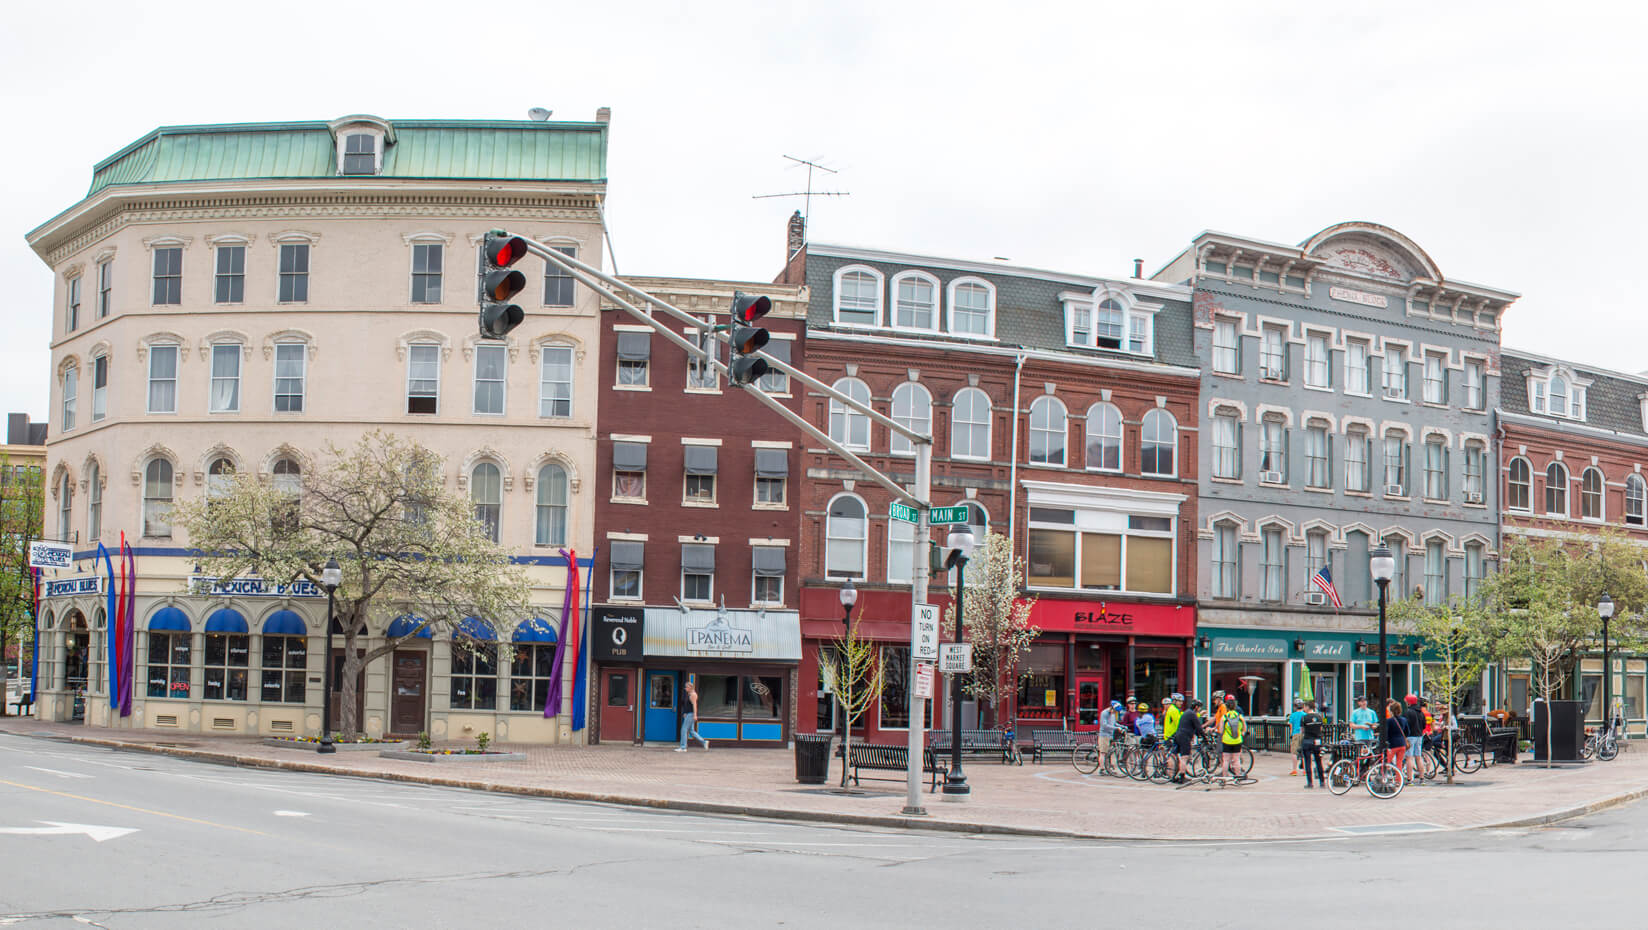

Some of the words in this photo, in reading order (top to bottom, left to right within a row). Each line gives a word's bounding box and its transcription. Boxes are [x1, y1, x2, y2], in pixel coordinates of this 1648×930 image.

[892, 503, 911, 521] BROAD
[912, 513, 917, 521] ST
[931, 508, 953, 522] MAIN
[958, 511, 966, 521] ST
[53, 581, 77, 594] MEXICALI
[79, 579, 98, 592] BLUES
[277, 582, 318, 595] BUES
[603, 615, 624, 623] Reverend
[920, 609, 932, 620] NO
[1074, 612, 1134, 625] BLAZE
[919, 622, 934, 632] TURN
[921, 634, 930, 643] ON
[612, 648, 627, 656] PUB
[920, 646, 931, 655] RED
[1216, 642, 1233, 653] The
[1235, 644, 1265, 654] Charles
[1267, 644, 1284, 654] Inn
[1312, 644, 1344, 655] Hotel
[170, 682, 190, 691] OPEN
